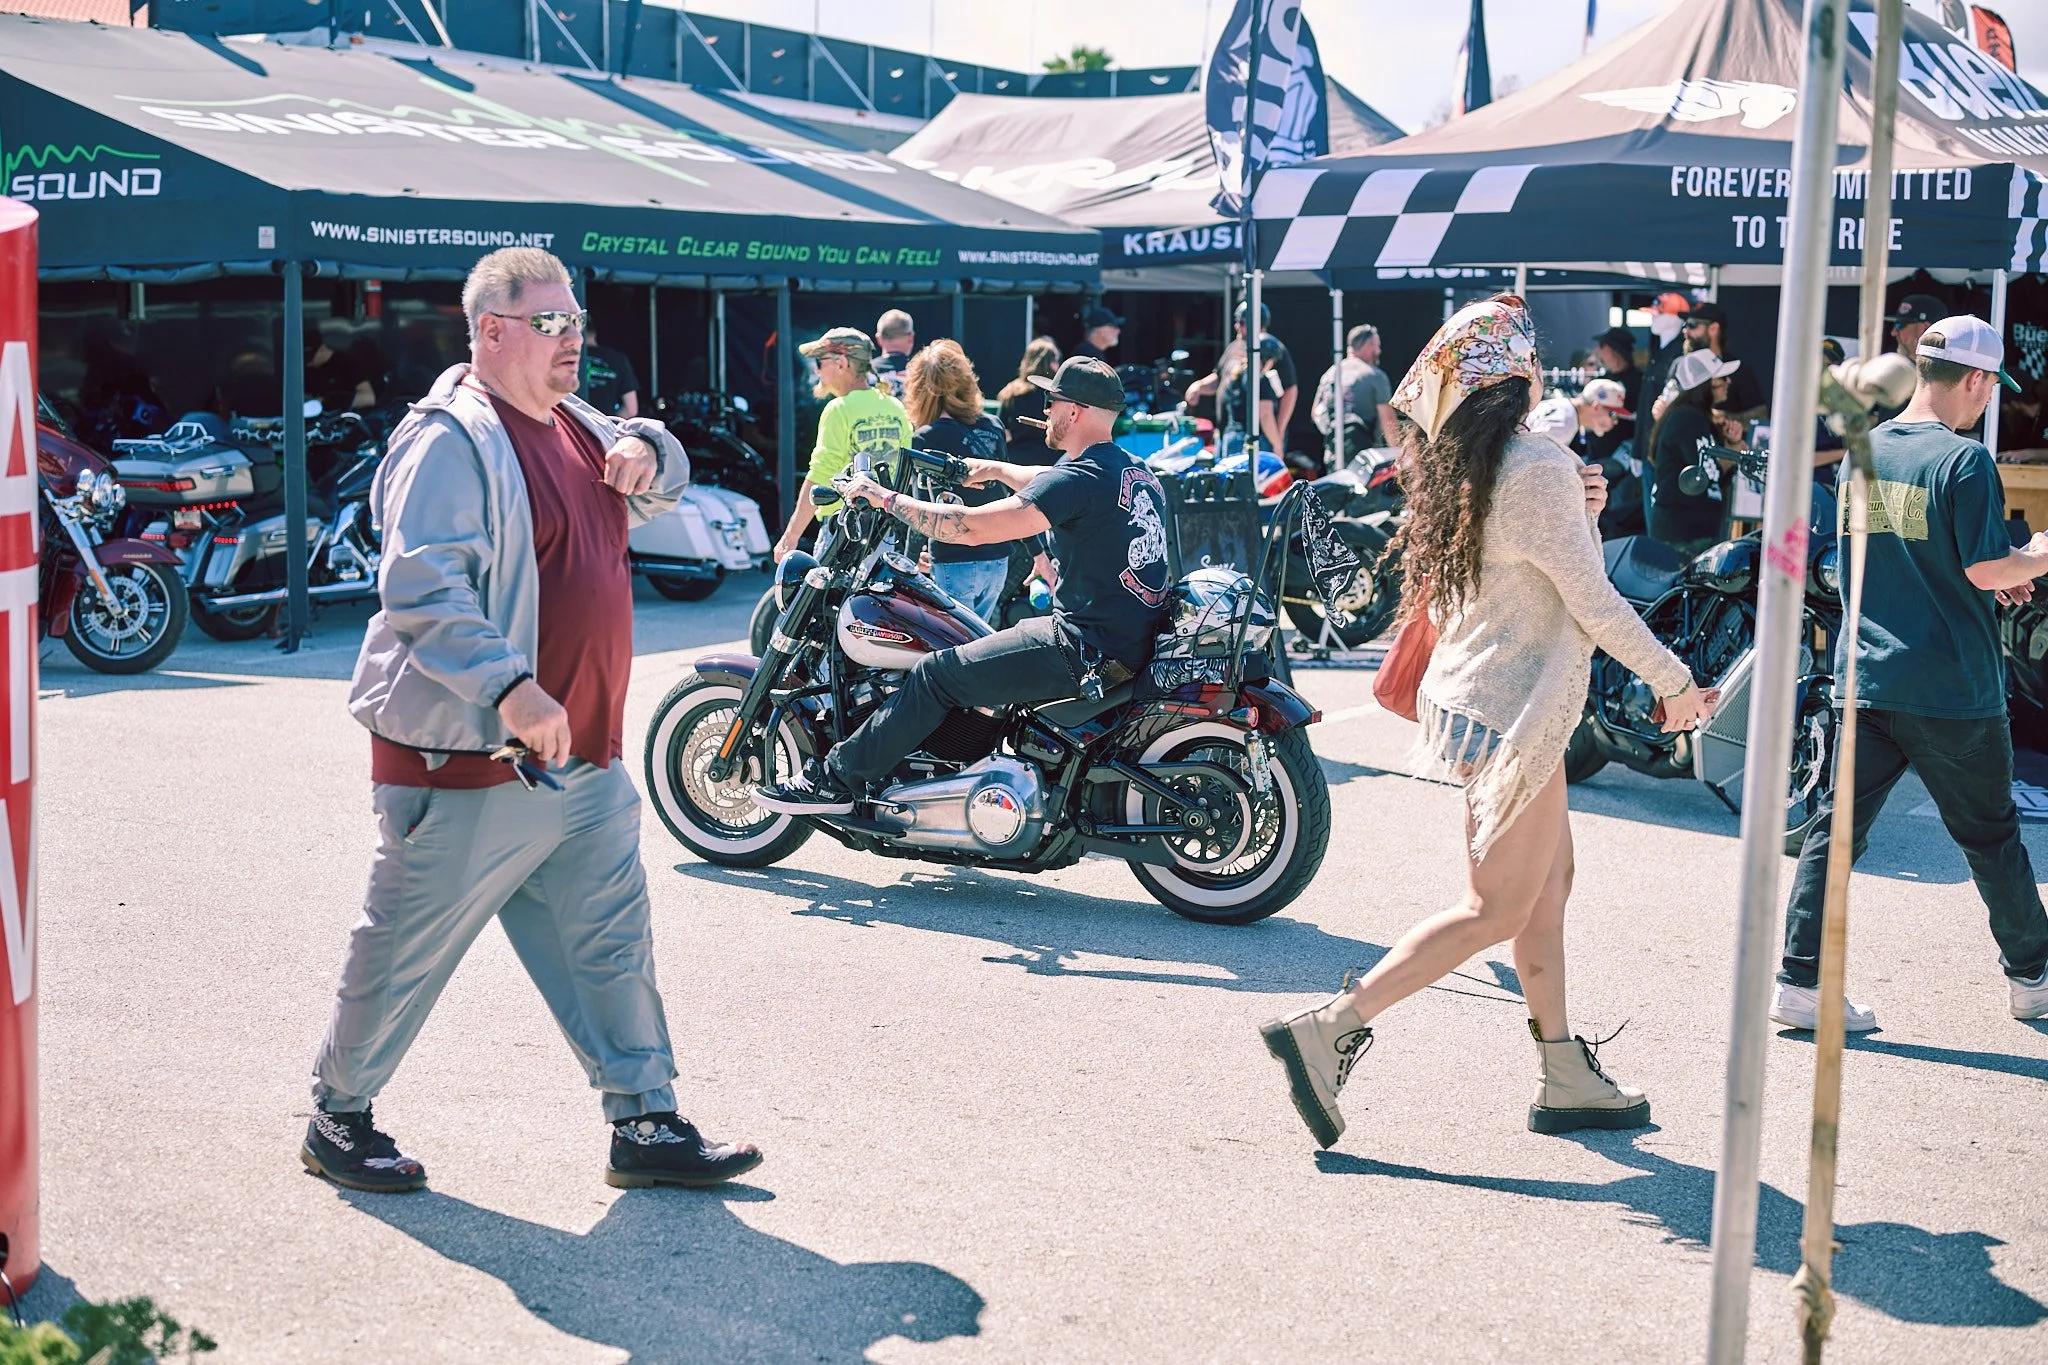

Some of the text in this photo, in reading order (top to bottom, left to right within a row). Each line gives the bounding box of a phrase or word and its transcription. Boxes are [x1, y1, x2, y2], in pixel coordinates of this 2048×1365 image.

[140, 105, 898, 176] SINISTER SOUND
[11, 168, 162, 201] SOUND
[1671, 166, 1972, 200] FOREVER MITTED
[1732, 216, 1766, 248] TO
[1838, 218, 1903, 250] RIE
[312, 1118, 355, 1152] AVIDSON
